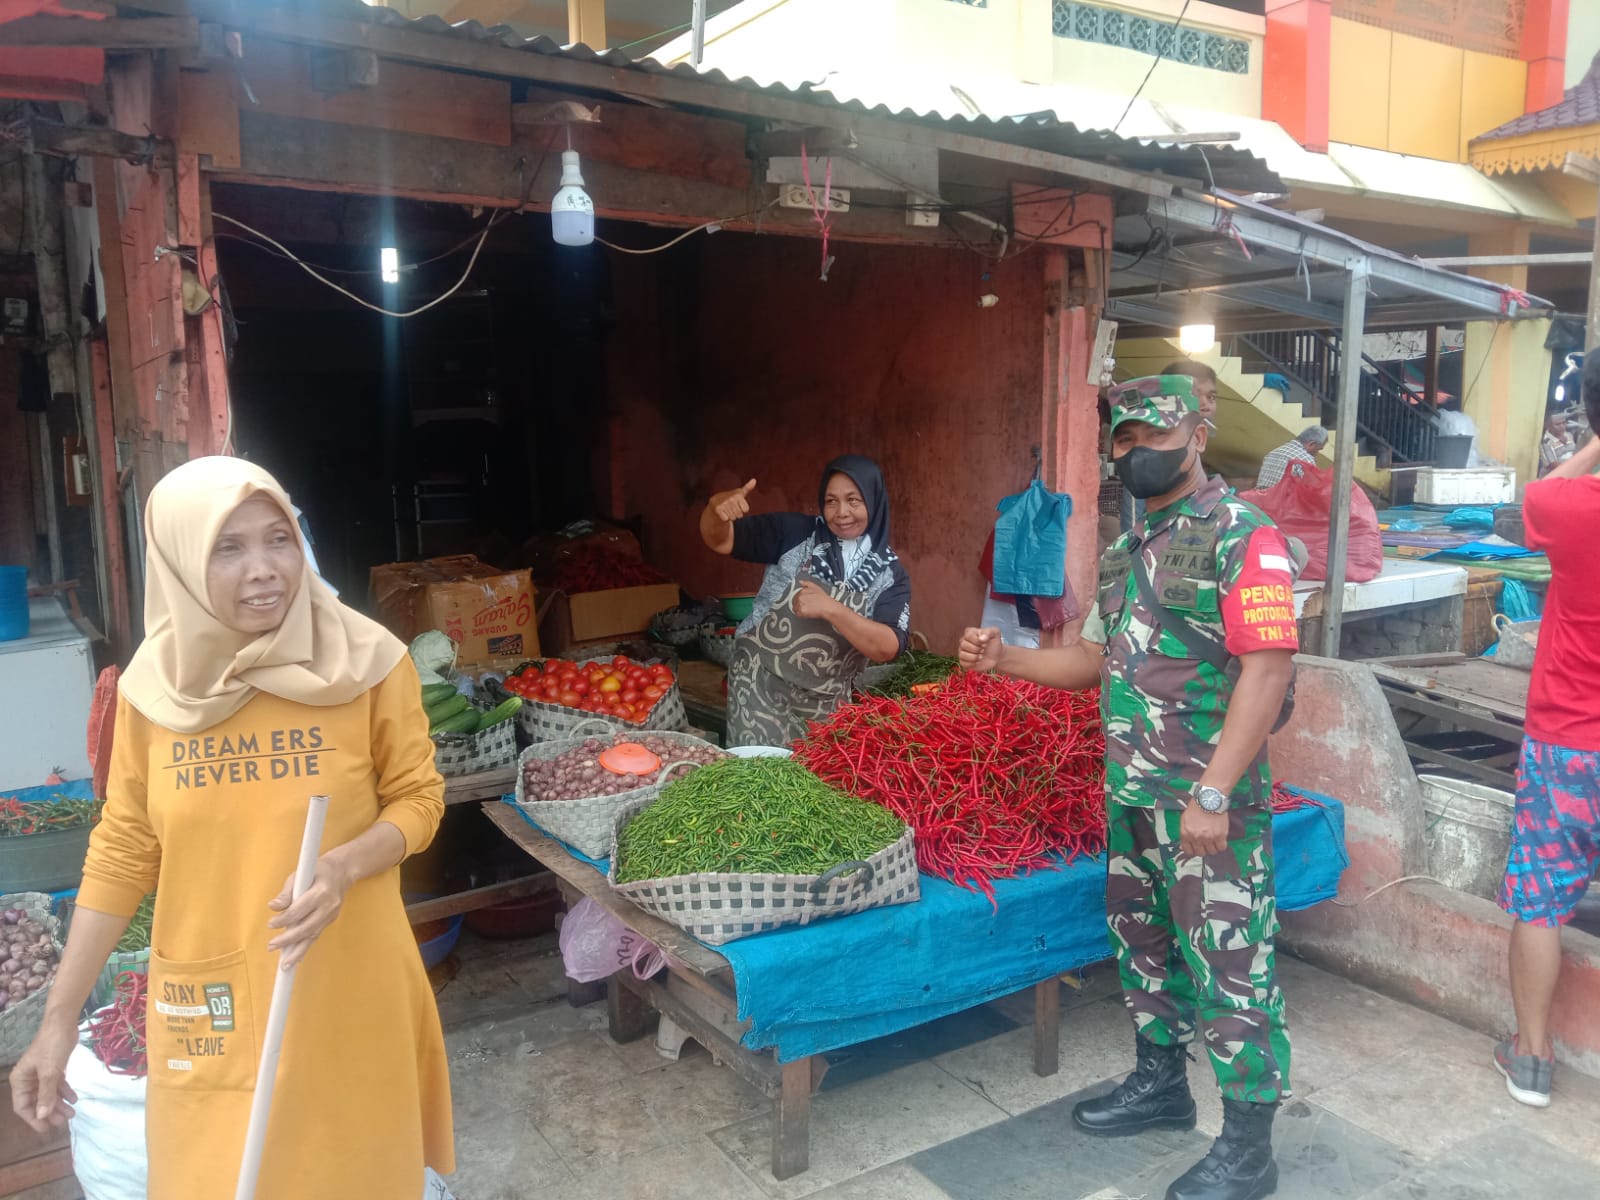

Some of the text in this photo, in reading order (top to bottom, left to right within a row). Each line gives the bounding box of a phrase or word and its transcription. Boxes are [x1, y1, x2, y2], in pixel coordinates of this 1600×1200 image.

[1163, 553, 1184, 567] TNI
[1243, 606, 1291, 624] PROTOKOL
[472, 624, 507, 635] GUDANG
[1257, 625, 1284, 641] TNI
[175, 754, 321, 790] NEVER DIE
[164, 982, 196, 1004] STAY
[210, 996, 231, 1015] OR
[186, 1037, 224, 1056] LEAVE
